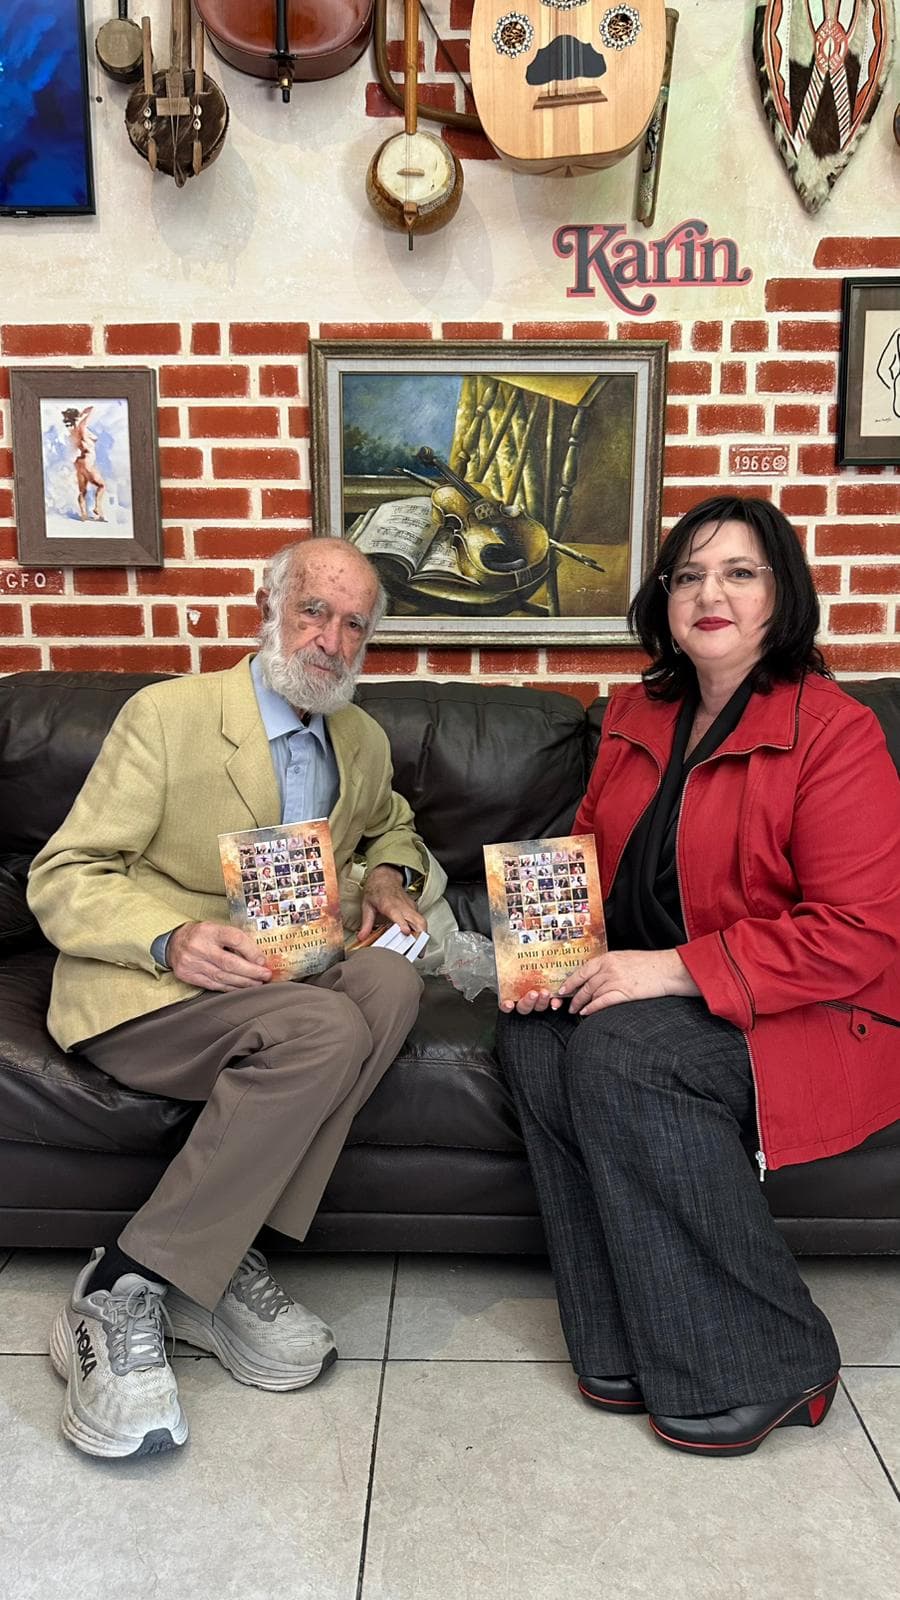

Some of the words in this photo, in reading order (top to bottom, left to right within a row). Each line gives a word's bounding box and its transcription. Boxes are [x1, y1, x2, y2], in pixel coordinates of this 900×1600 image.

[552, 218, 753, 316] Karin
[735, 455, 770, 471] 1966
[262, 939, 326, 956] ЕПАТРИАНТЫ
[75, 1319, 97, 1382] HOKA
